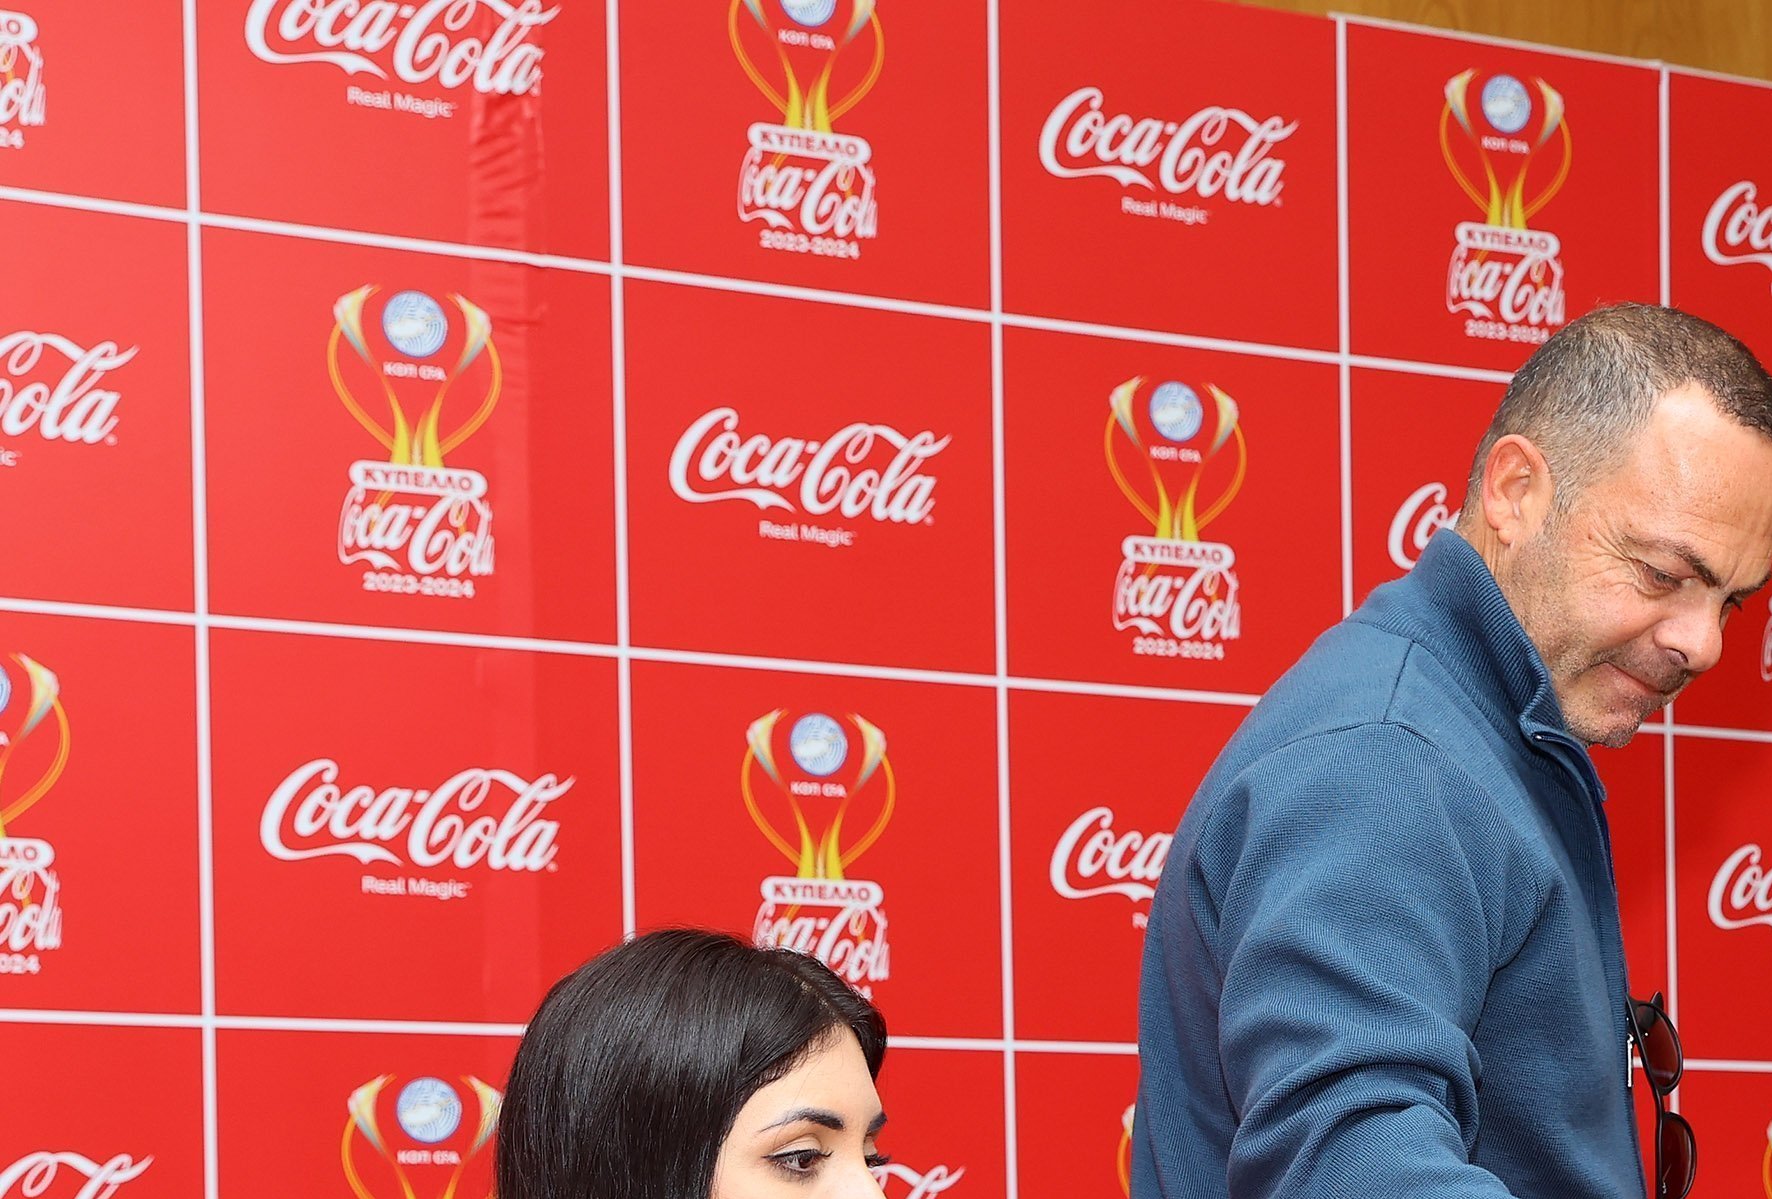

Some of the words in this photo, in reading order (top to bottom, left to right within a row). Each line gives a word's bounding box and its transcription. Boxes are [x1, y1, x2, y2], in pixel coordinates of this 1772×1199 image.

[346, 86, 391, 109] Real
[394, 93, 452, 118] Magic
[1038, 86, 1298, 207] Coca-Cola
[1122, 197, 1157, 216] Real
[1160, 203, 1206, 225] Magic
[362, 467, 473, 491] ΚΥΠΕΛΛΟ
[668, 407, 951, 526] Coca-Cola
[760, 521, 798, 540] Real
[801, 525, 852, 547] Magic
[363, 572, 475, 597] 2023-2024
[260, 759, 574, 871] Coca-Cola
[362, 876, 406, 894] Real
[408, 878, 467, 900] Magic
